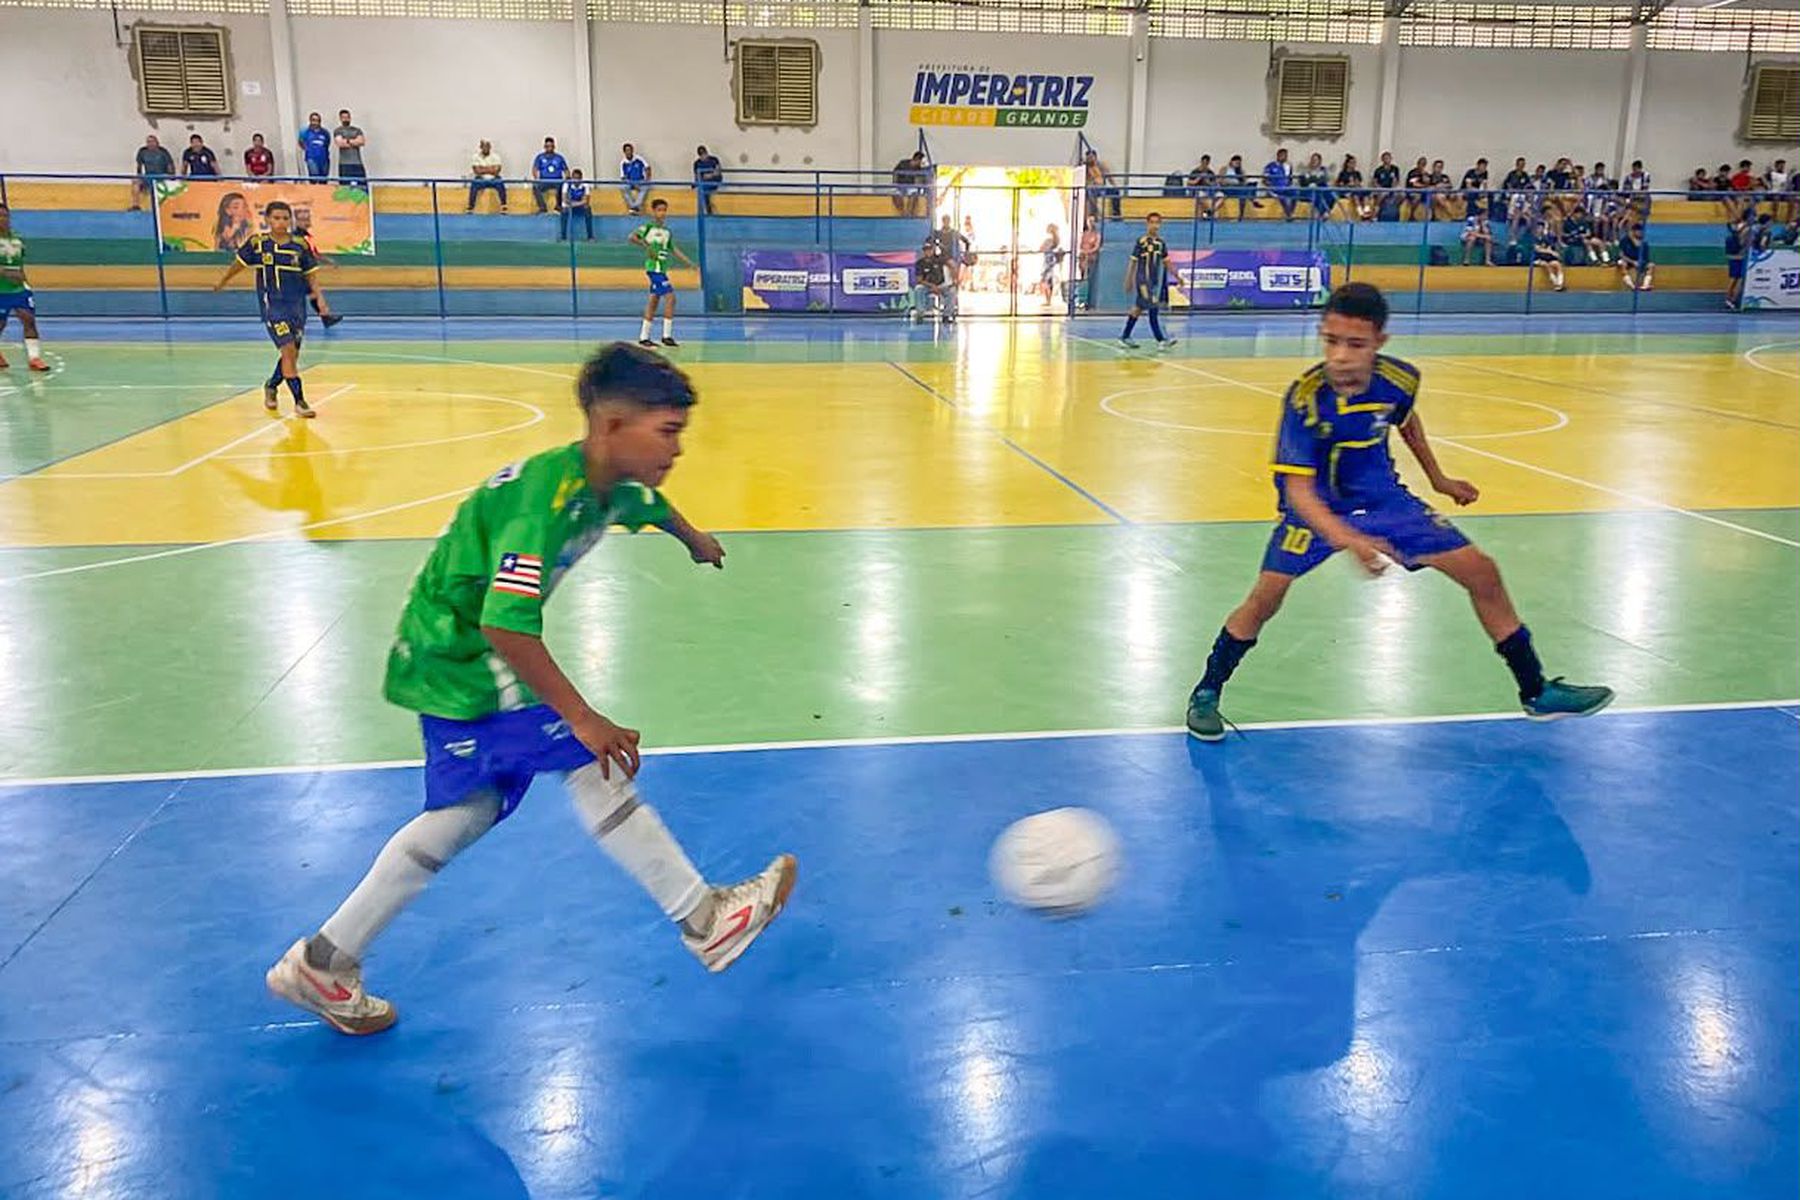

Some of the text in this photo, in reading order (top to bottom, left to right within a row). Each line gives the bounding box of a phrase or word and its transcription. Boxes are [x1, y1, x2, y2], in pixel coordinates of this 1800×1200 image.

[918, 64, 975, 72] PREFEITURA
[912, 72, 1095, 107] IMPERATRIZ
[919, 109, 1082, 125] CIDADE GRANDE
[809, 273, 840, 283] SEDL
[274, 321, 290, 336] 20
[1281, 524, 1313, 555] 10
